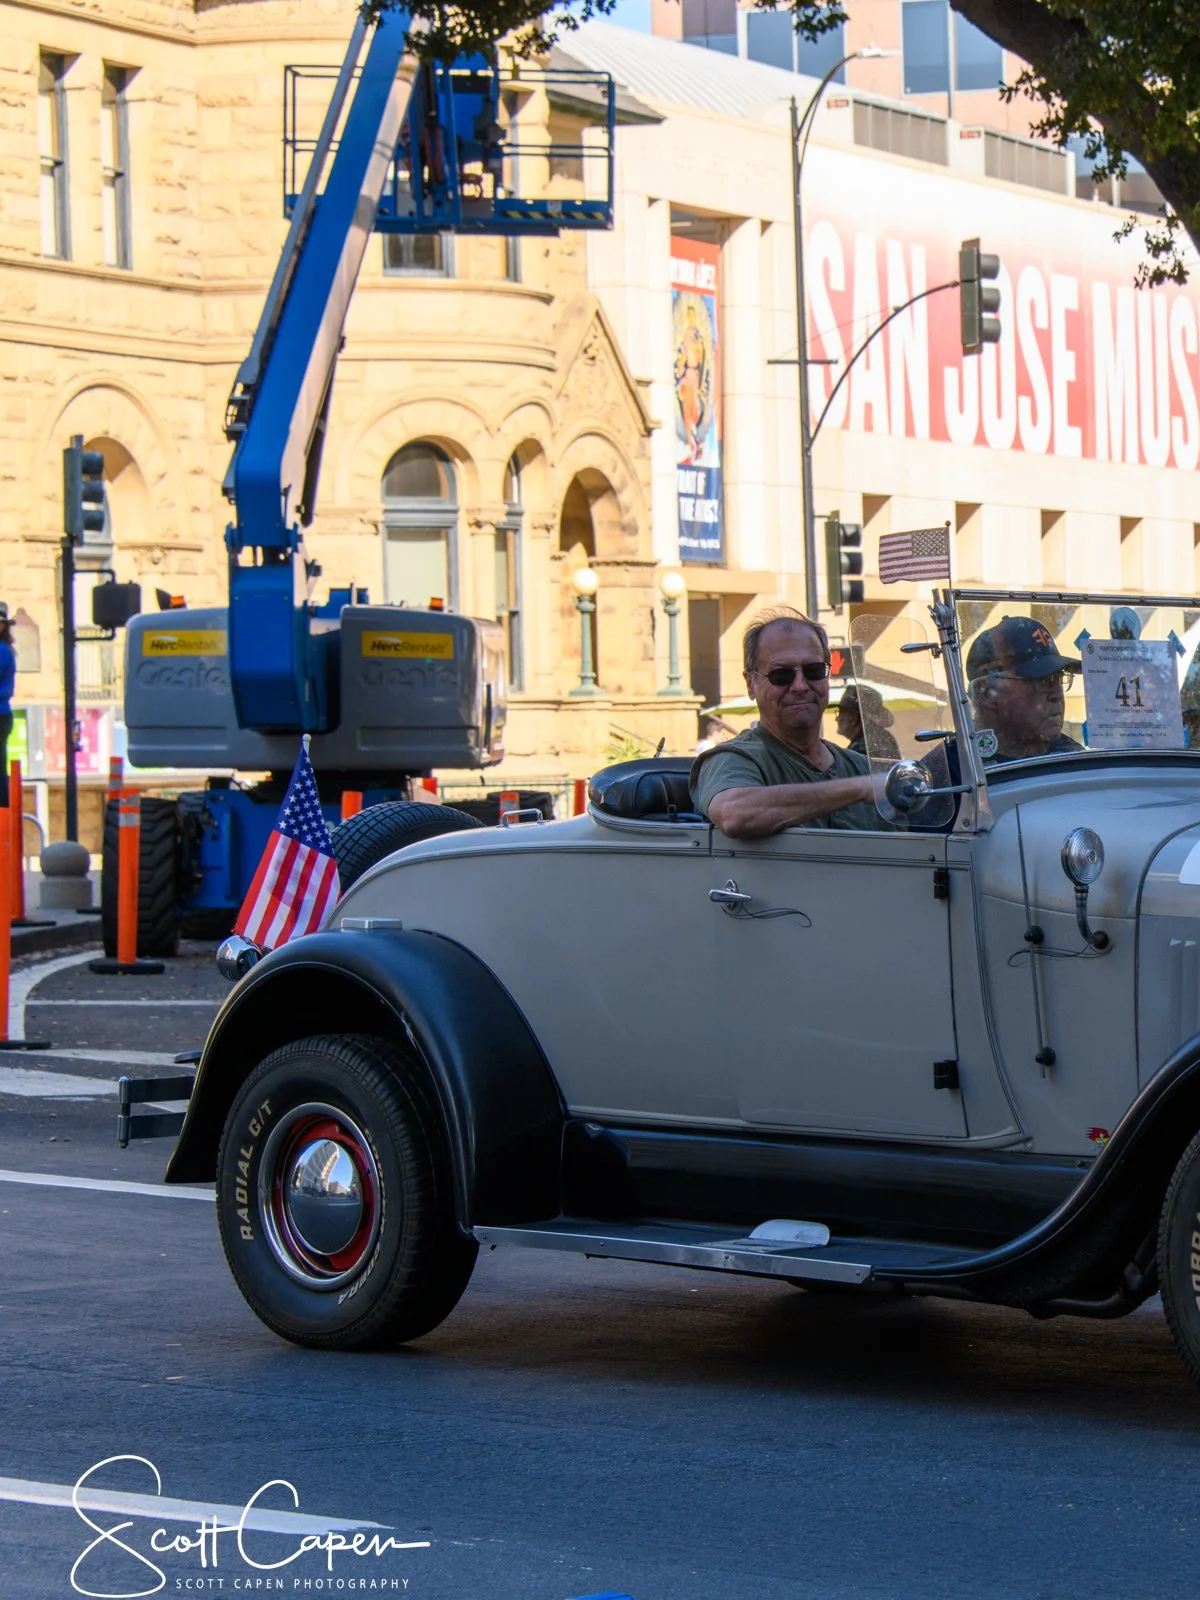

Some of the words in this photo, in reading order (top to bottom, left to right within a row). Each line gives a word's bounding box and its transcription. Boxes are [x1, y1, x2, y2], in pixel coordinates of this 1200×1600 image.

[808, 220, 930, 441] SAN
[943, 258, 1082, 458] JOSE
[1115, 672, 1145, 708] 41
[235, 1145, 255, 1240] RADIAL
[248, 1100, 272, 1138] G/T
